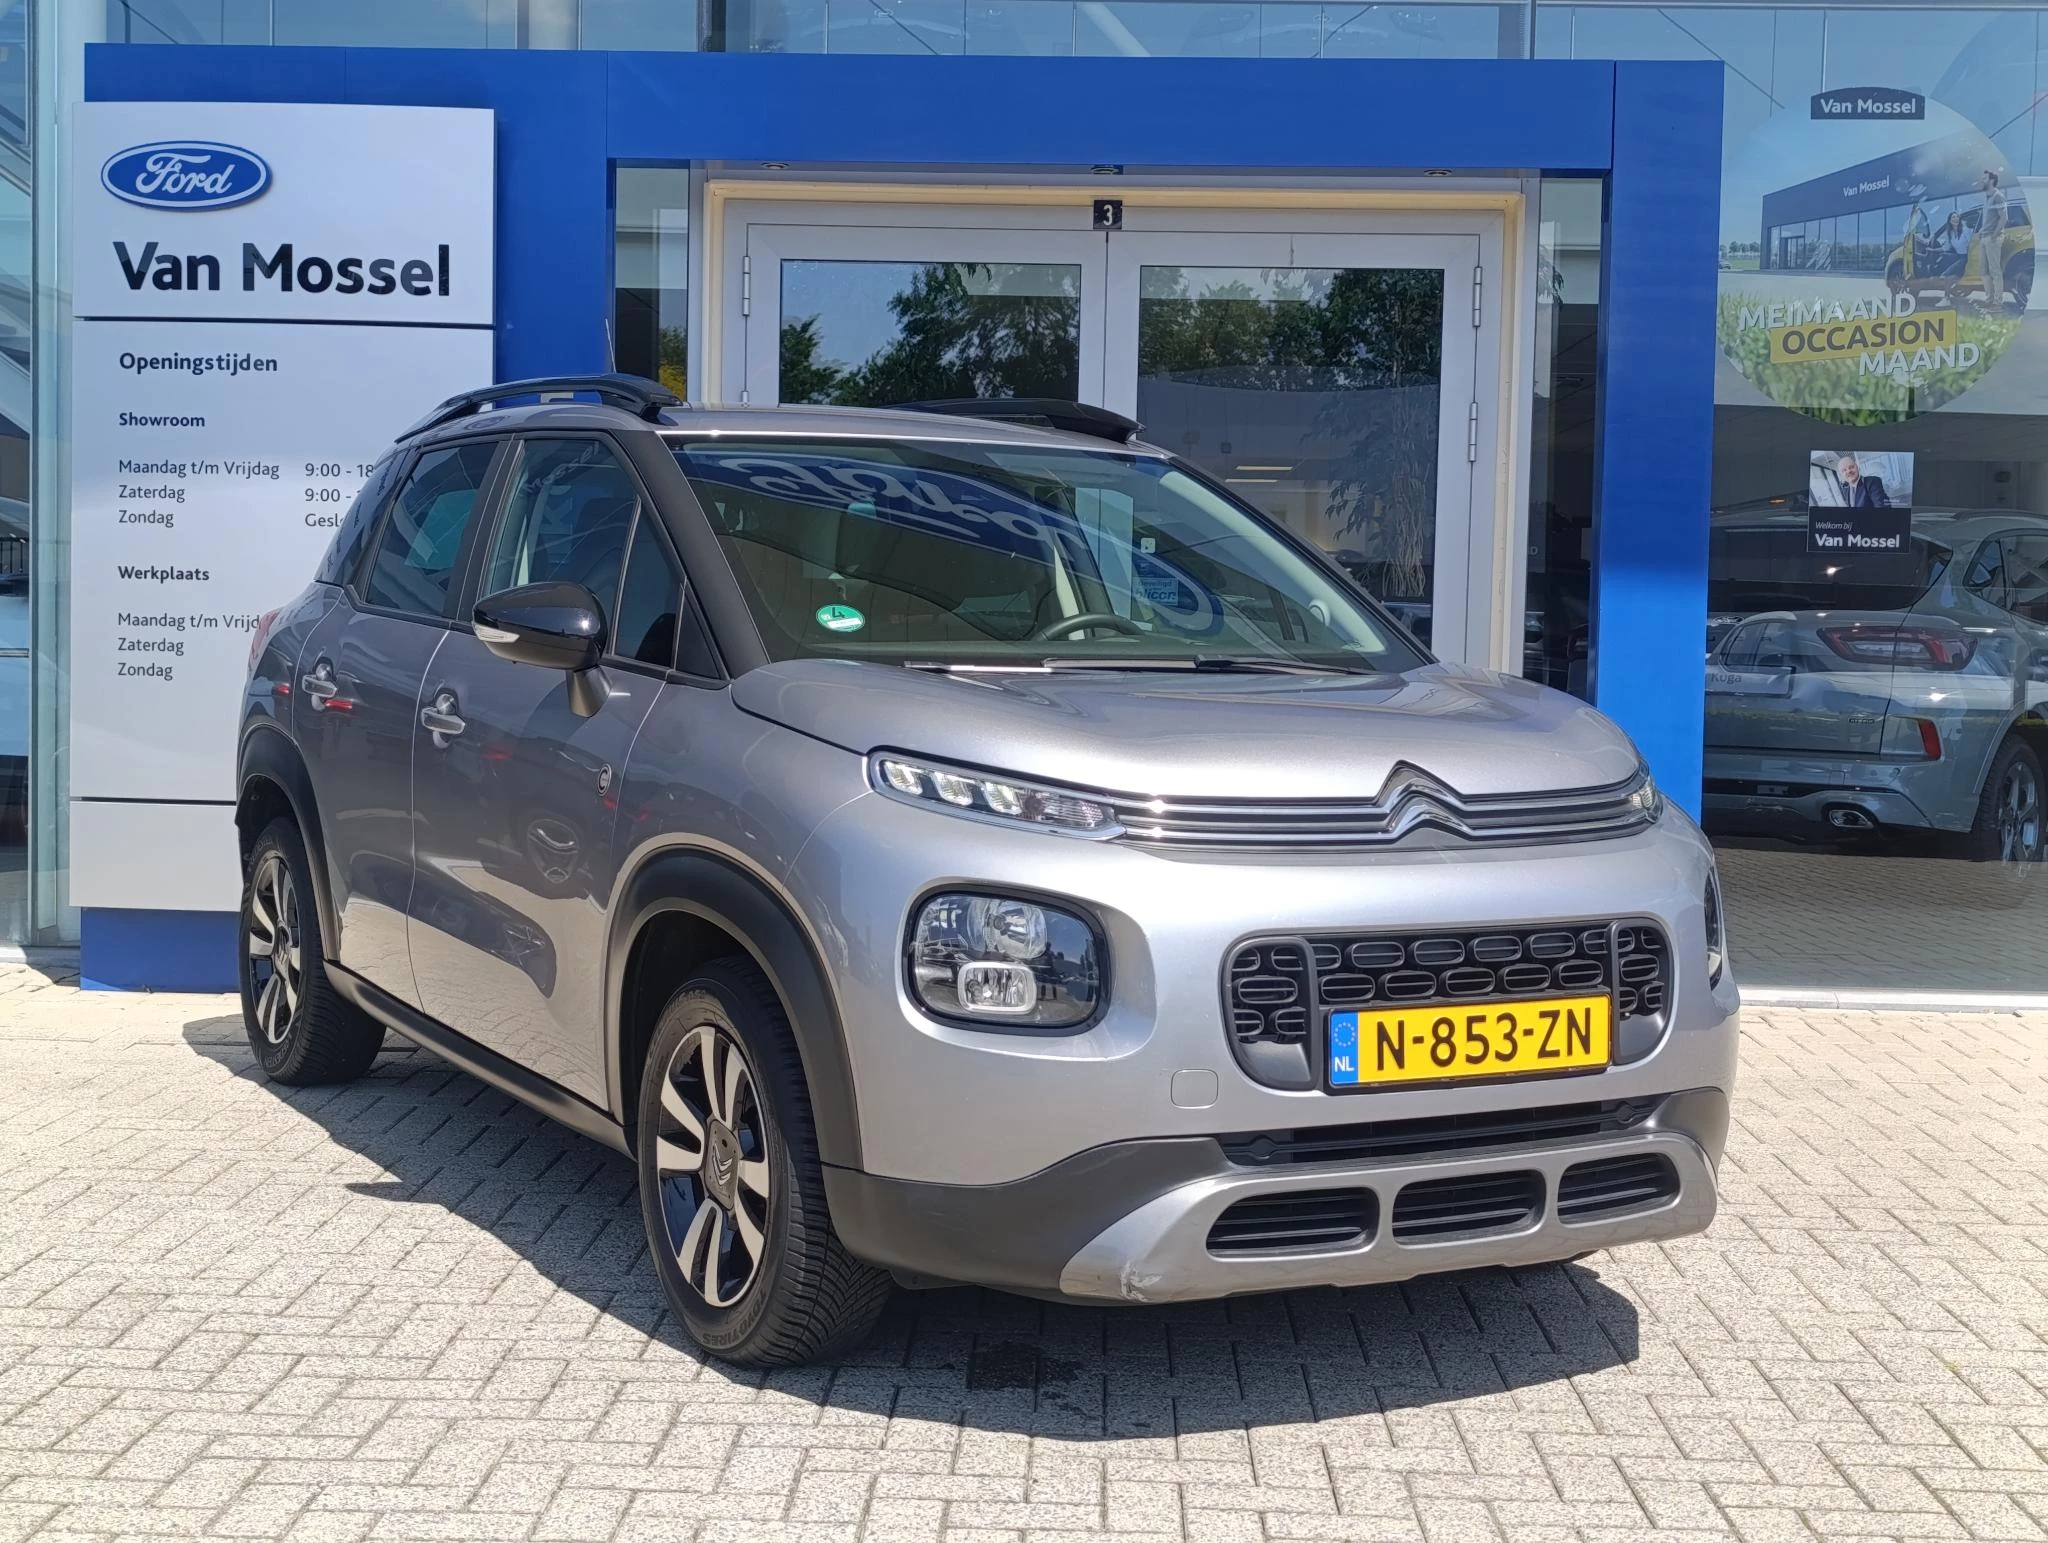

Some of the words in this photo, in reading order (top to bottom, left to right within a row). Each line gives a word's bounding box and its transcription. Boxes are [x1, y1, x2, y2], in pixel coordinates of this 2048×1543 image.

[1820, 98, 1852, 114] Van
[1857, 98, 1916, 114] Mossel
[135, 152, 236, 194] Ford
[1842, 186, 1858, 198] Van
[1859, 174, 1890, 195] Mossel
[1103, 204, 1113, 226] 3
[112, 241, 221, 291] Van
[242, 243, 450, 297] Mossel
[1782, 318, 1945, 356] OCCASION
[119, 352, 278, 376] Openingstijden
[1859, 343, 1981, 377] MAAND
[119, 412, 206, 428] Showroom
[119, 459, 187, 478] Maandag
[191, 460, 219, 476] t/m
[224, 461, 280, 480] Vrijdag
[305, 463, 341, 477] 9:00
[118, 485, 186, 503] Zaterdag
[305, 488, 341, 502] 9:00
[118, 510, 174, 528] Zondag
[1815, 534, 1843, 547] Van
[1847, 534, 1900, 548] Mossel
[118, 566, 210, 584] Werkplaats
[118, 613, 186, 631] Maandag
[190, 614, 218, 629] t/m
[118, 638, 185, 656] Zaterdag
[118, 663, 174, 682] Zondag
[1376, 1007, 1592, 1071] N-853-ZN
[1334, 1055, 1355, 1073] NL
